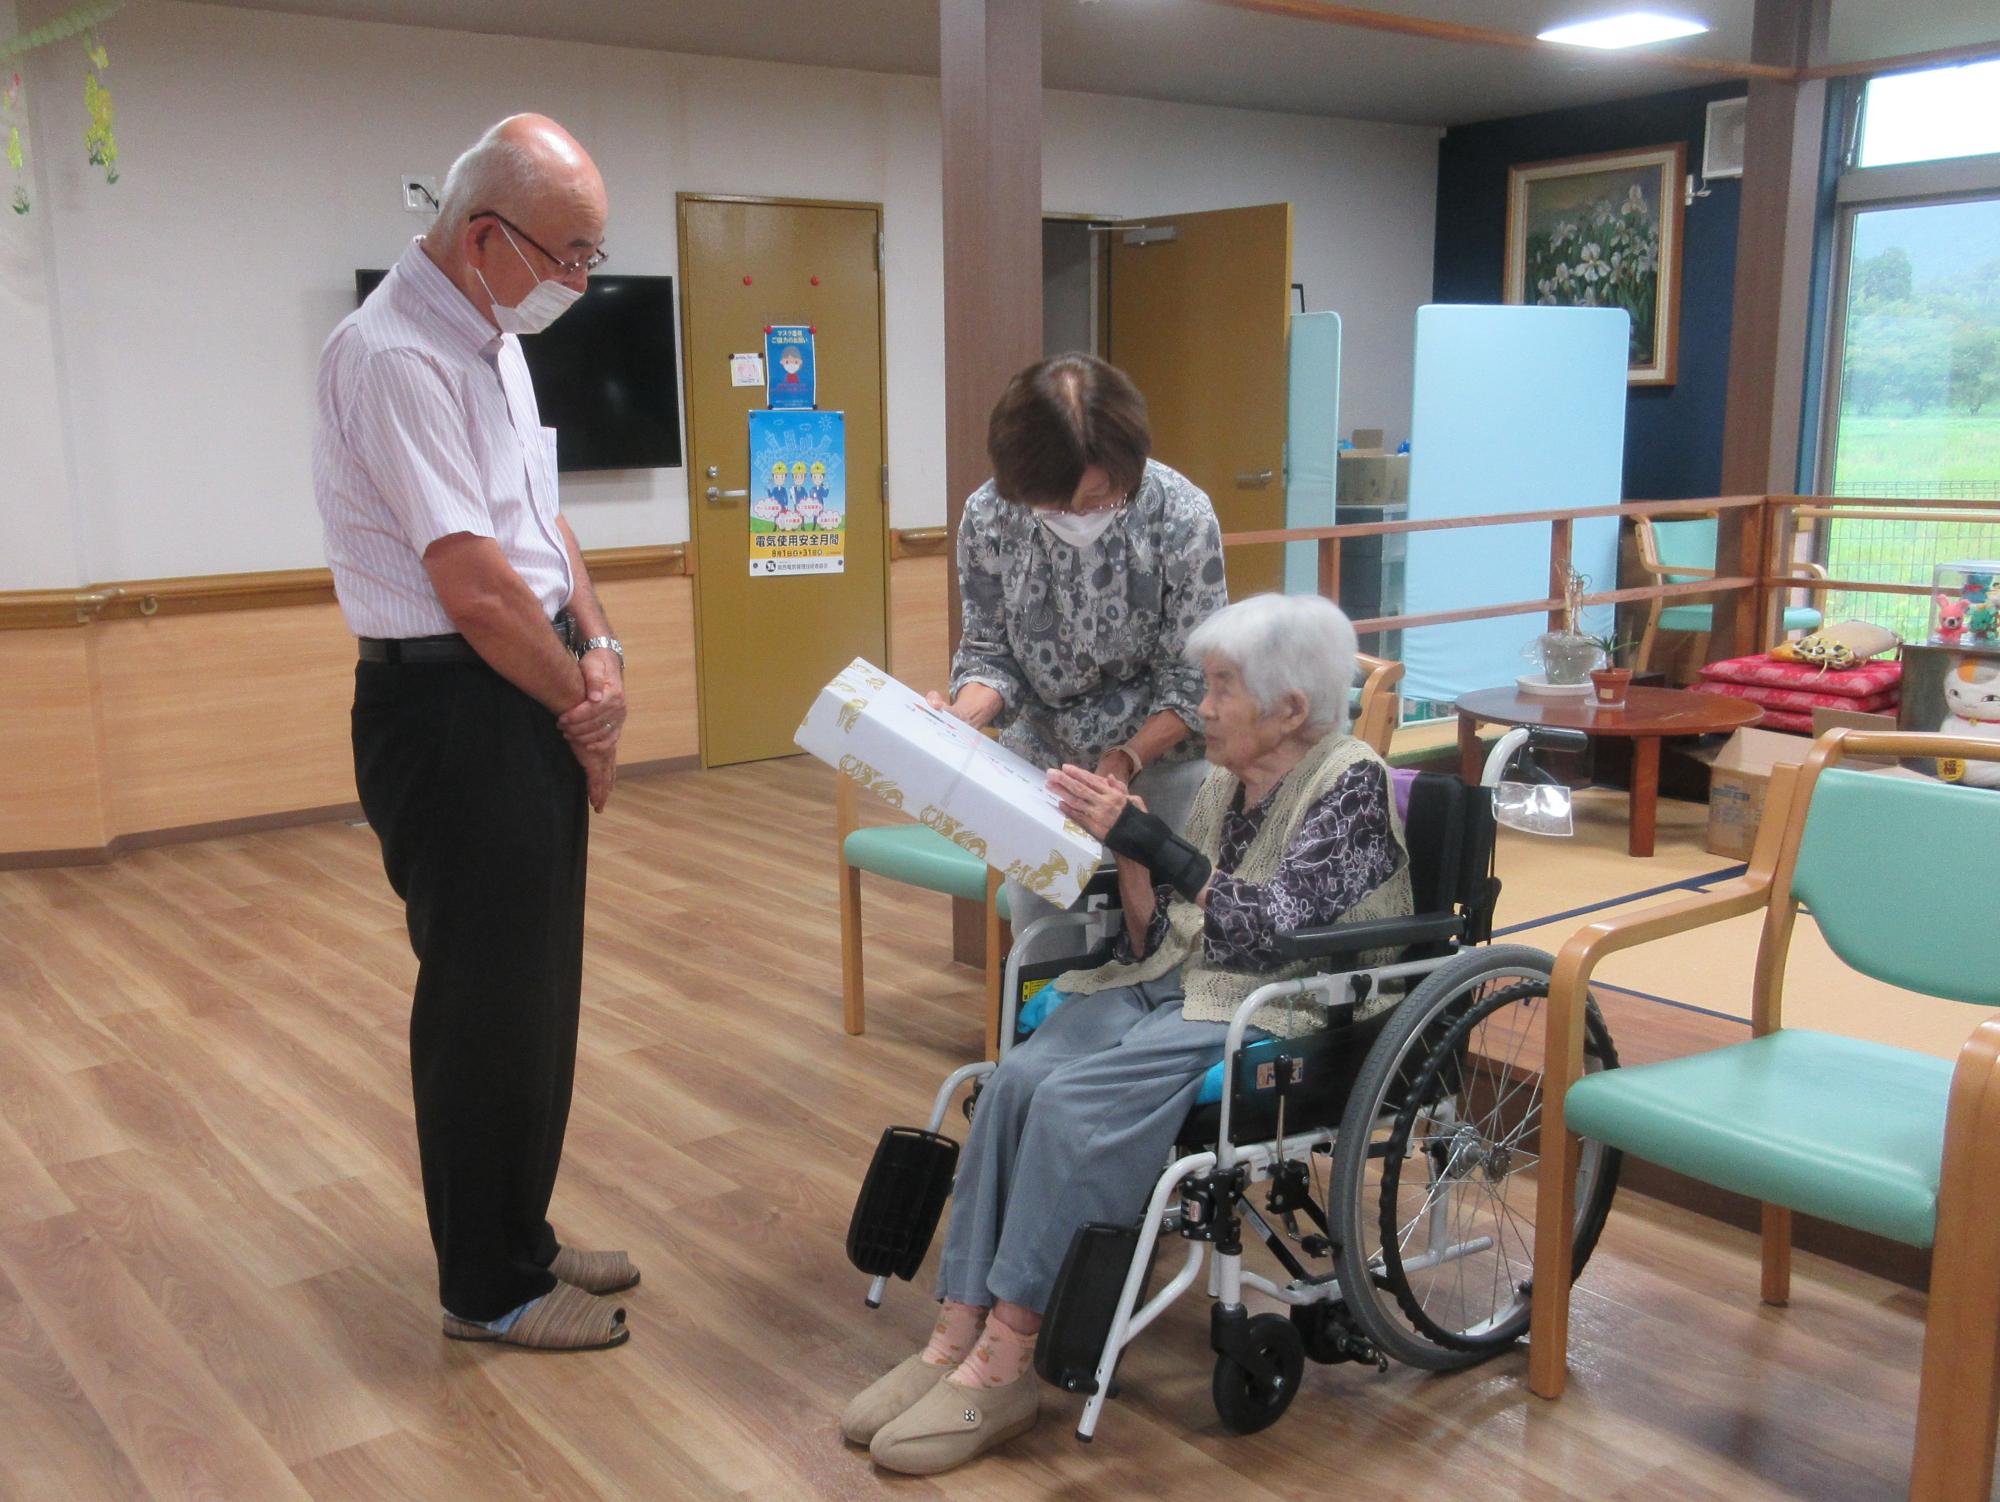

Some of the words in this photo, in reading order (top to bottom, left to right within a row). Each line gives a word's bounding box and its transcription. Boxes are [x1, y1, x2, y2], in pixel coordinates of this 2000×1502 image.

[756, 534, 839, 547] 電気使用安全月間
